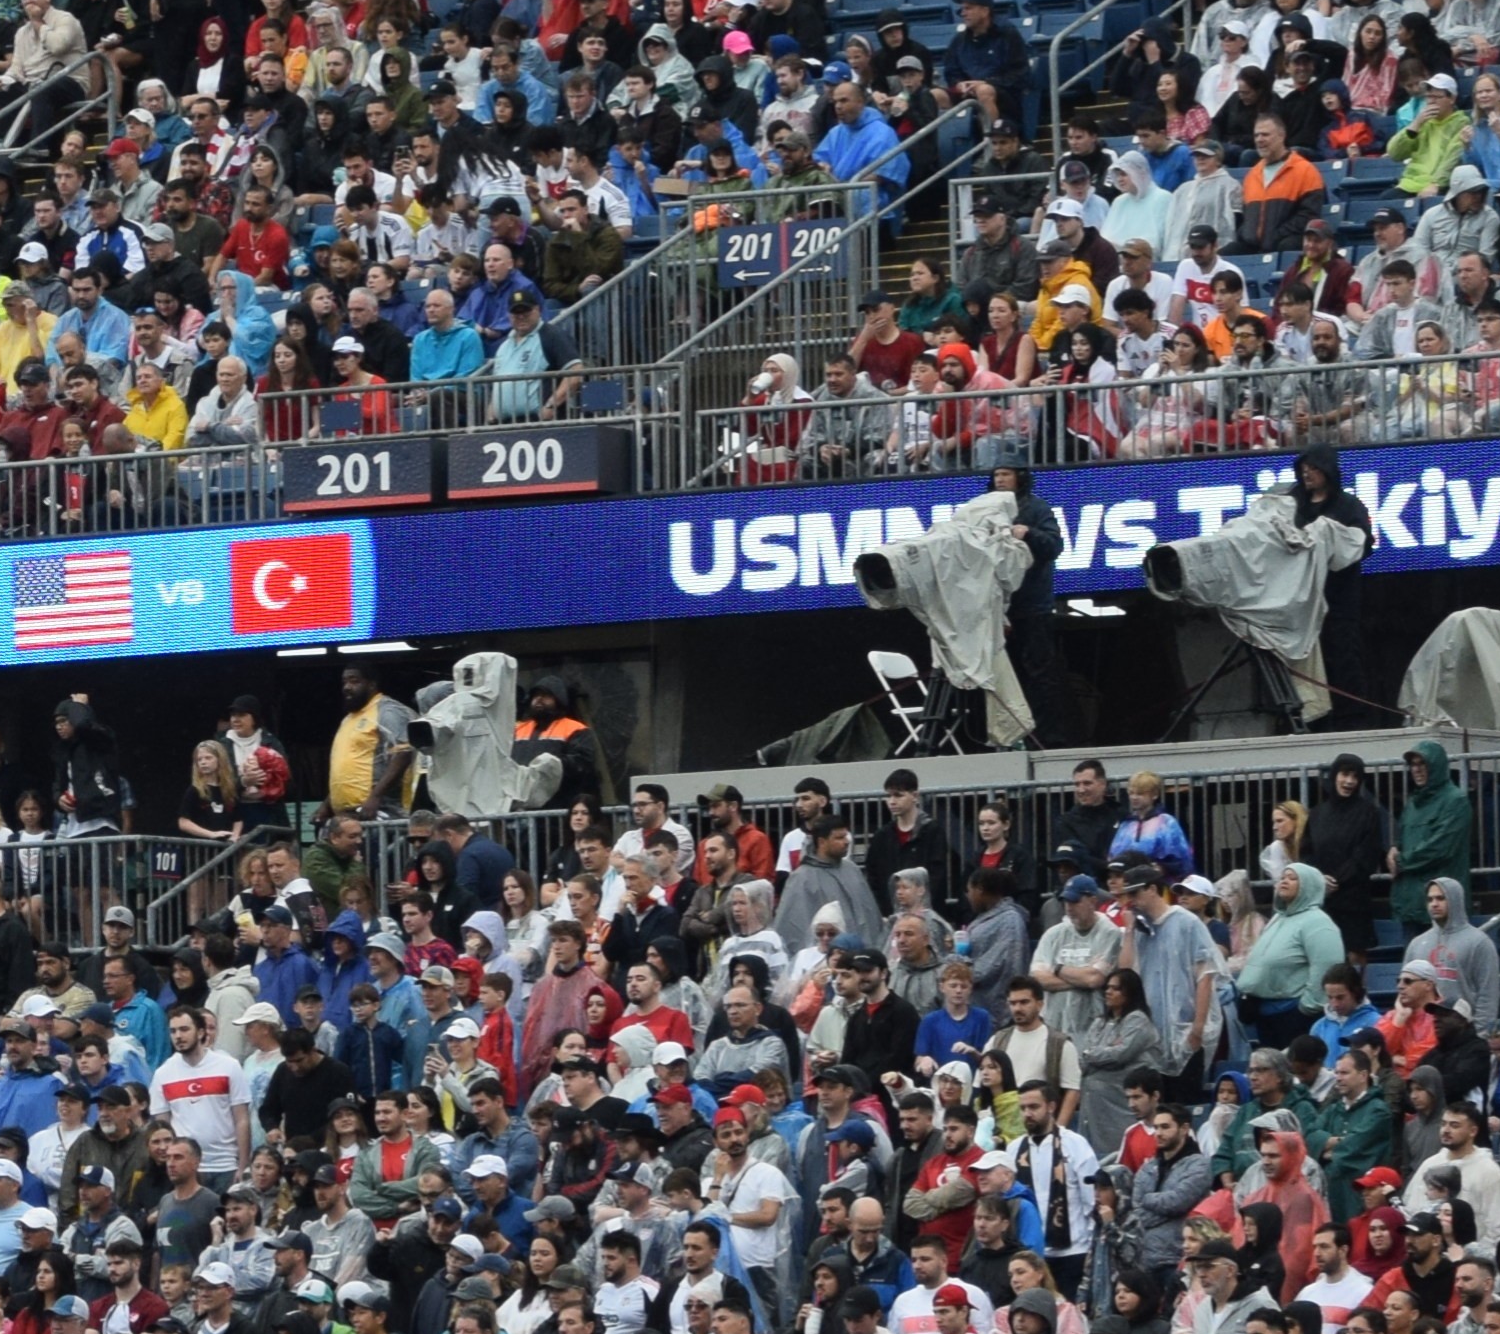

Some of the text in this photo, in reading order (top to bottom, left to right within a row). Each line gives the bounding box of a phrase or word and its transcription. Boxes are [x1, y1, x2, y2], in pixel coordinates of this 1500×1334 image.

[725, 225, 842, 263] 201 200
[316, 451, 390, 496] 201
[482, 437, 563, 483] 200
[1056, 499, 1156, 570] vs
[156, 579, 203, 606] vs
[155, 851, 176, 872] 101
